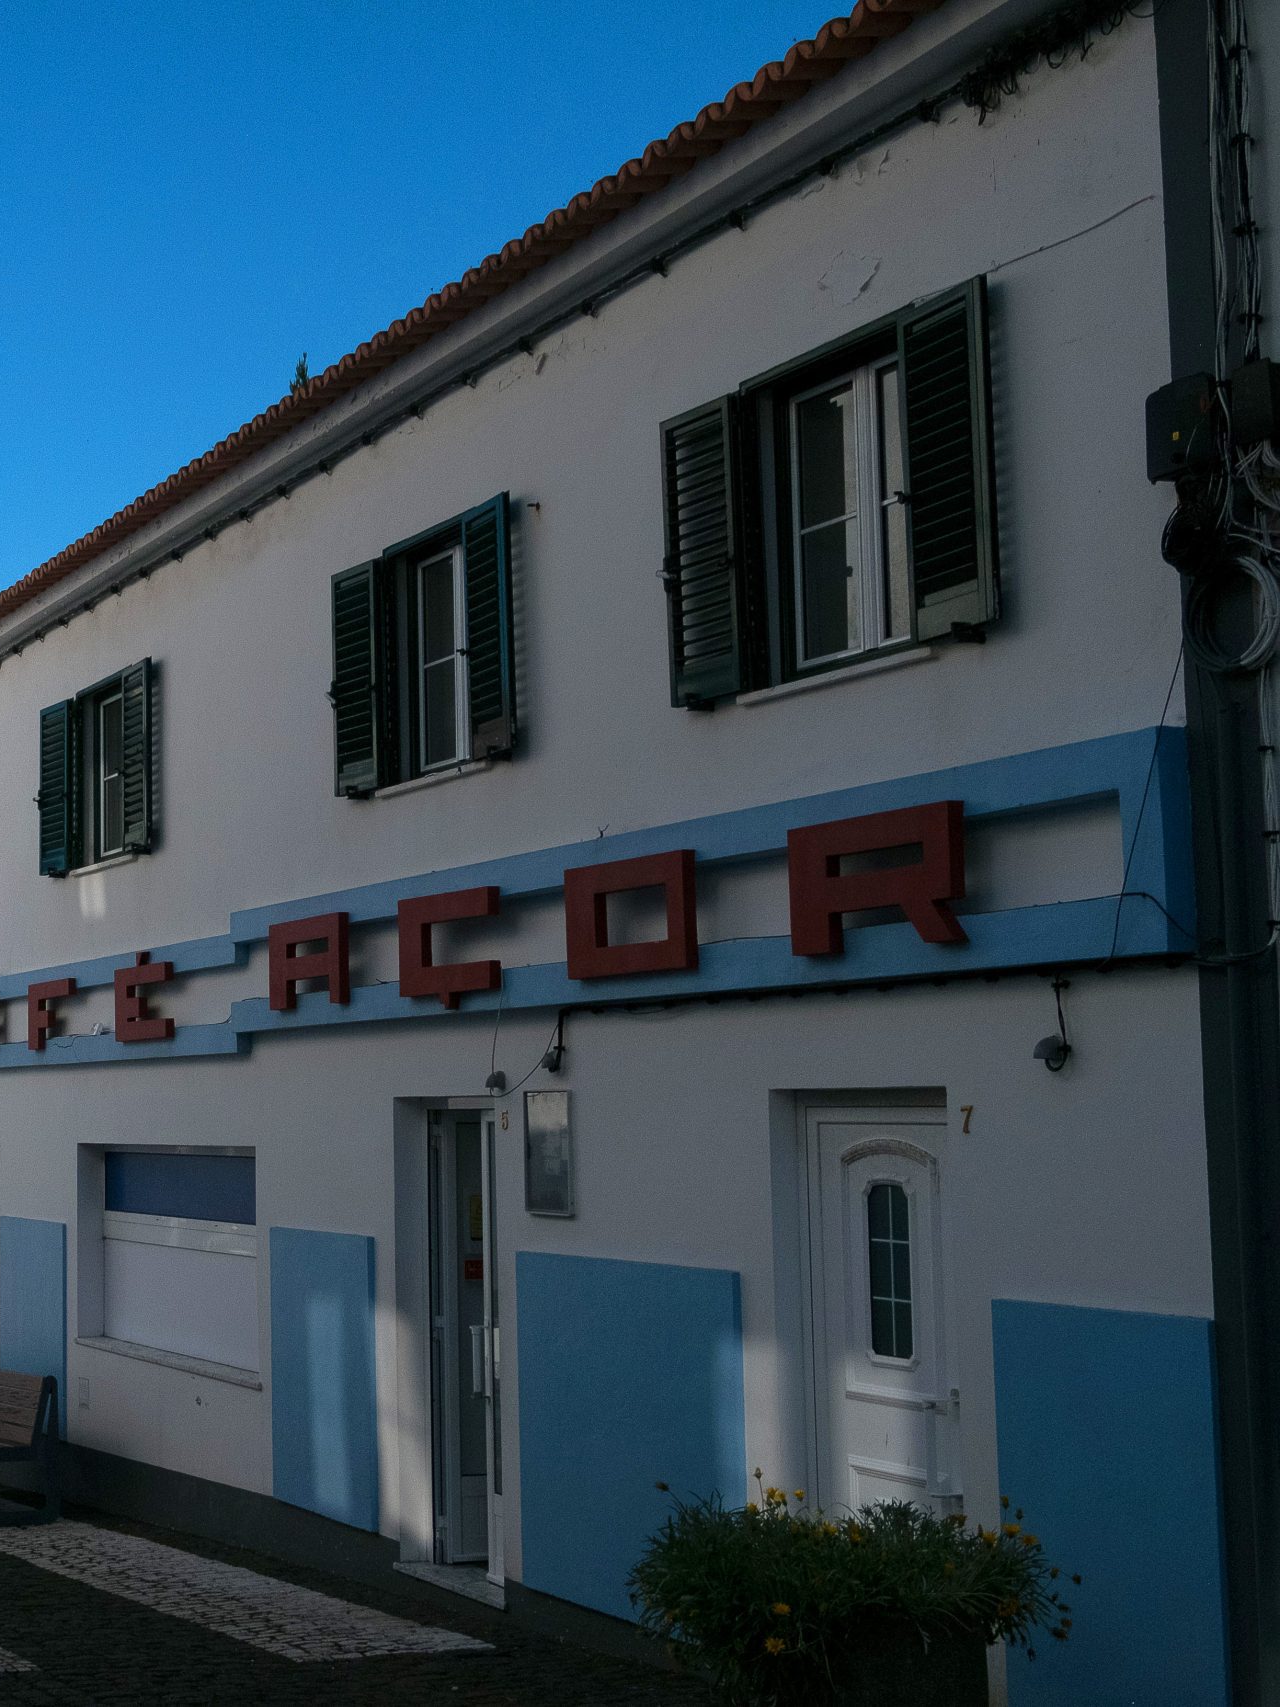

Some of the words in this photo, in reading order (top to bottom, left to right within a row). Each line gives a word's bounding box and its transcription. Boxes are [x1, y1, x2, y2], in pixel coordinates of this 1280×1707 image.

[268, 800, 970, 1011] AÇOR
[501, 1110, 510, 1131] 5
[960, 1105, 973, 1135] 7
